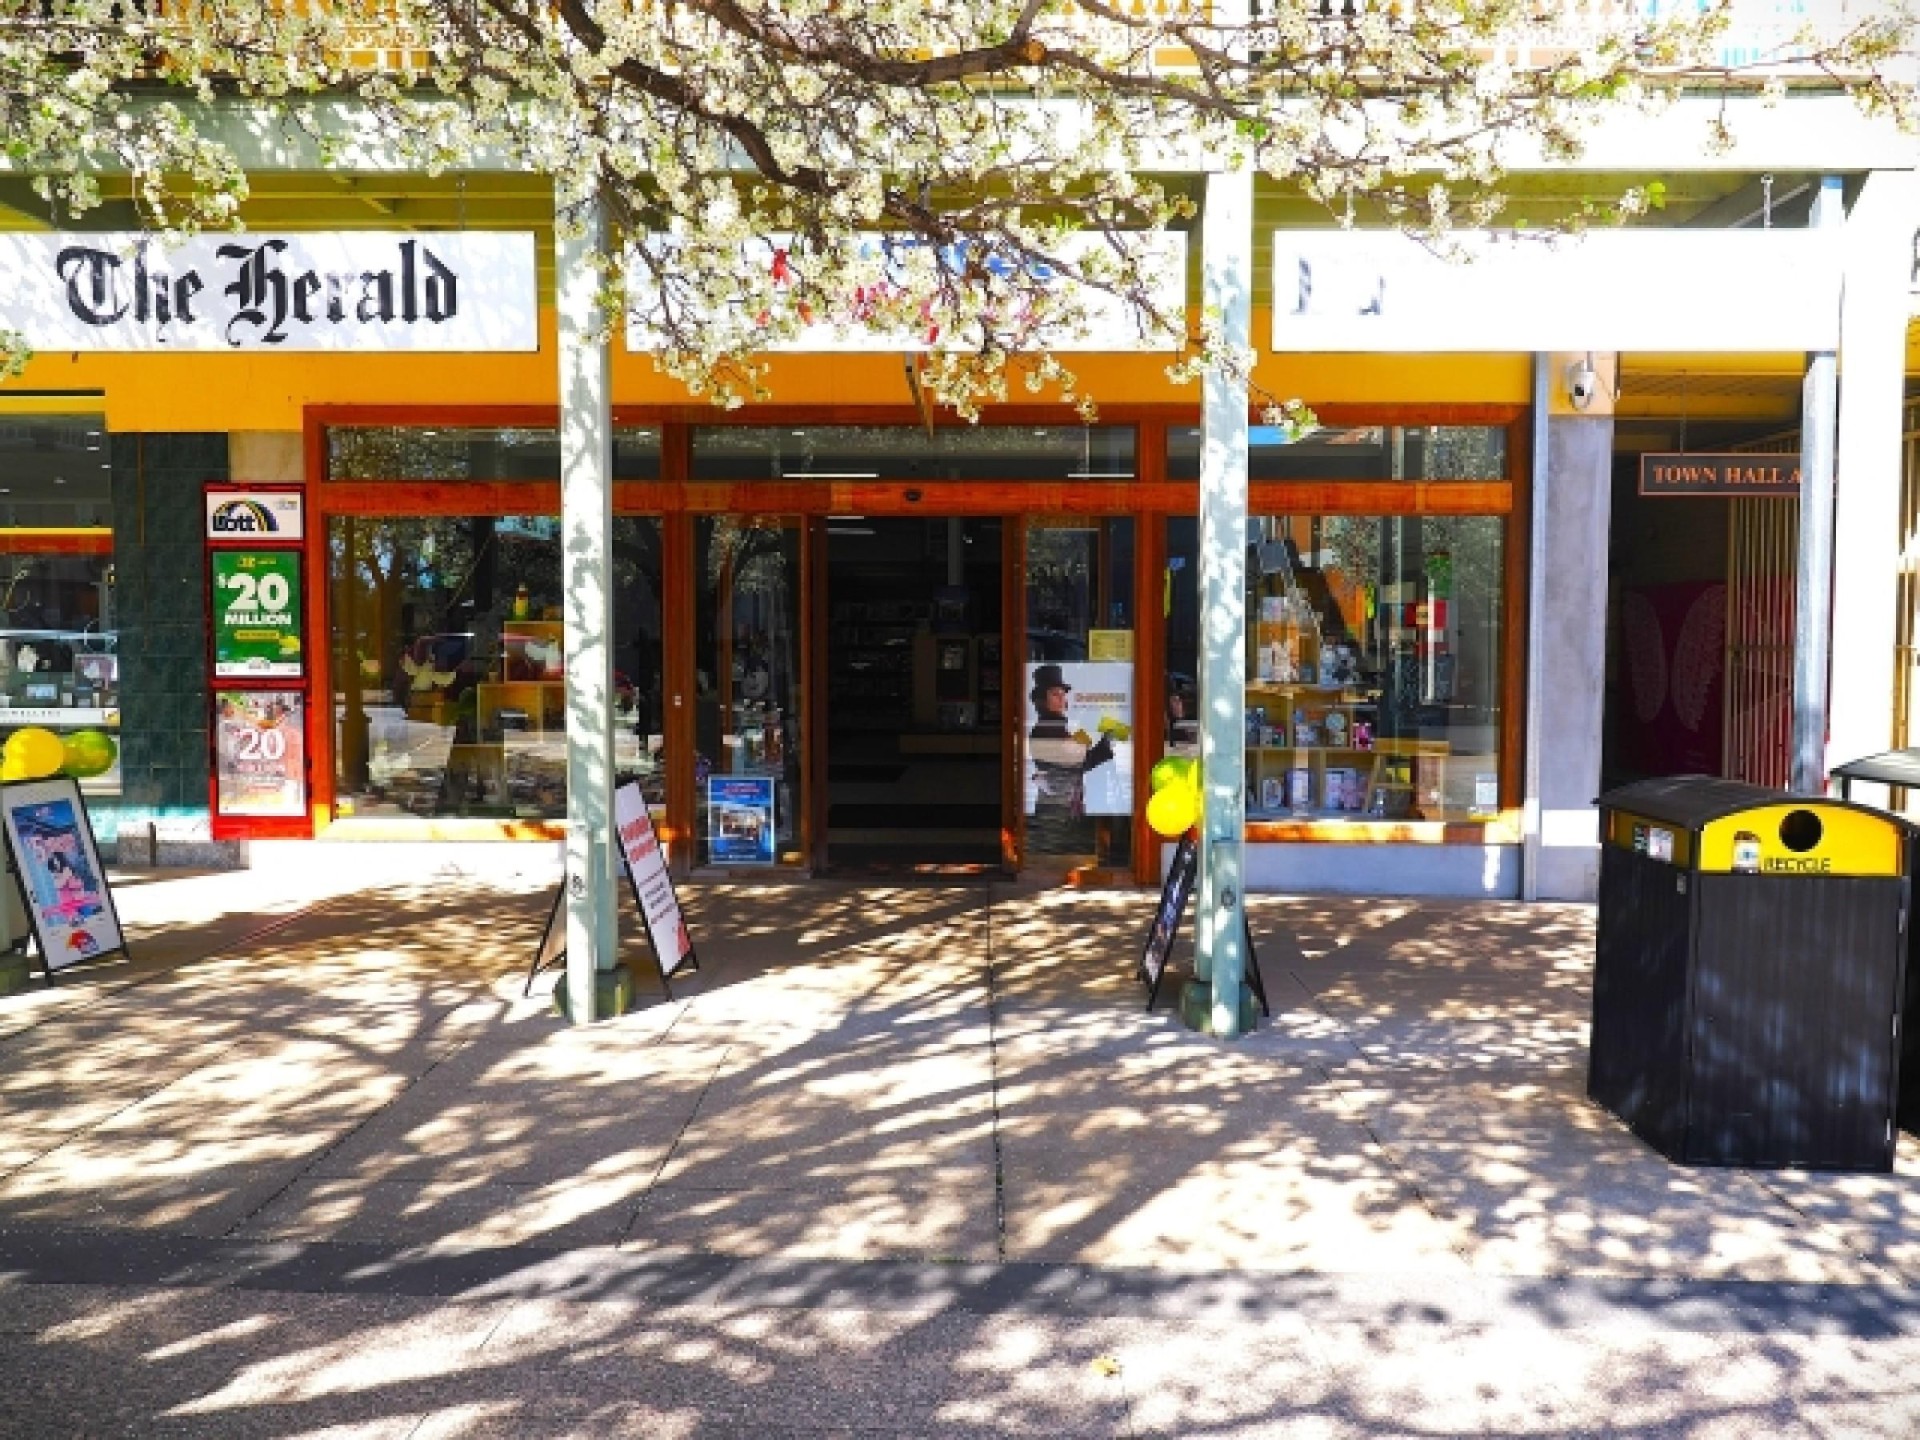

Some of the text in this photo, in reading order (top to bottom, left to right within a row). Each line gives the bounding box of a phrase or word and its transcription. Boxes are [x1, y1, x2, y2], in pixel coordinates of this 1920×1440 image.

[57, 236, 458, 347] The Herald
[1653, 465, 1717, 483] TOWN
[1725, 467, 1785, 483] HALL
[1763, 856, 1831, 873] RECYCLE
